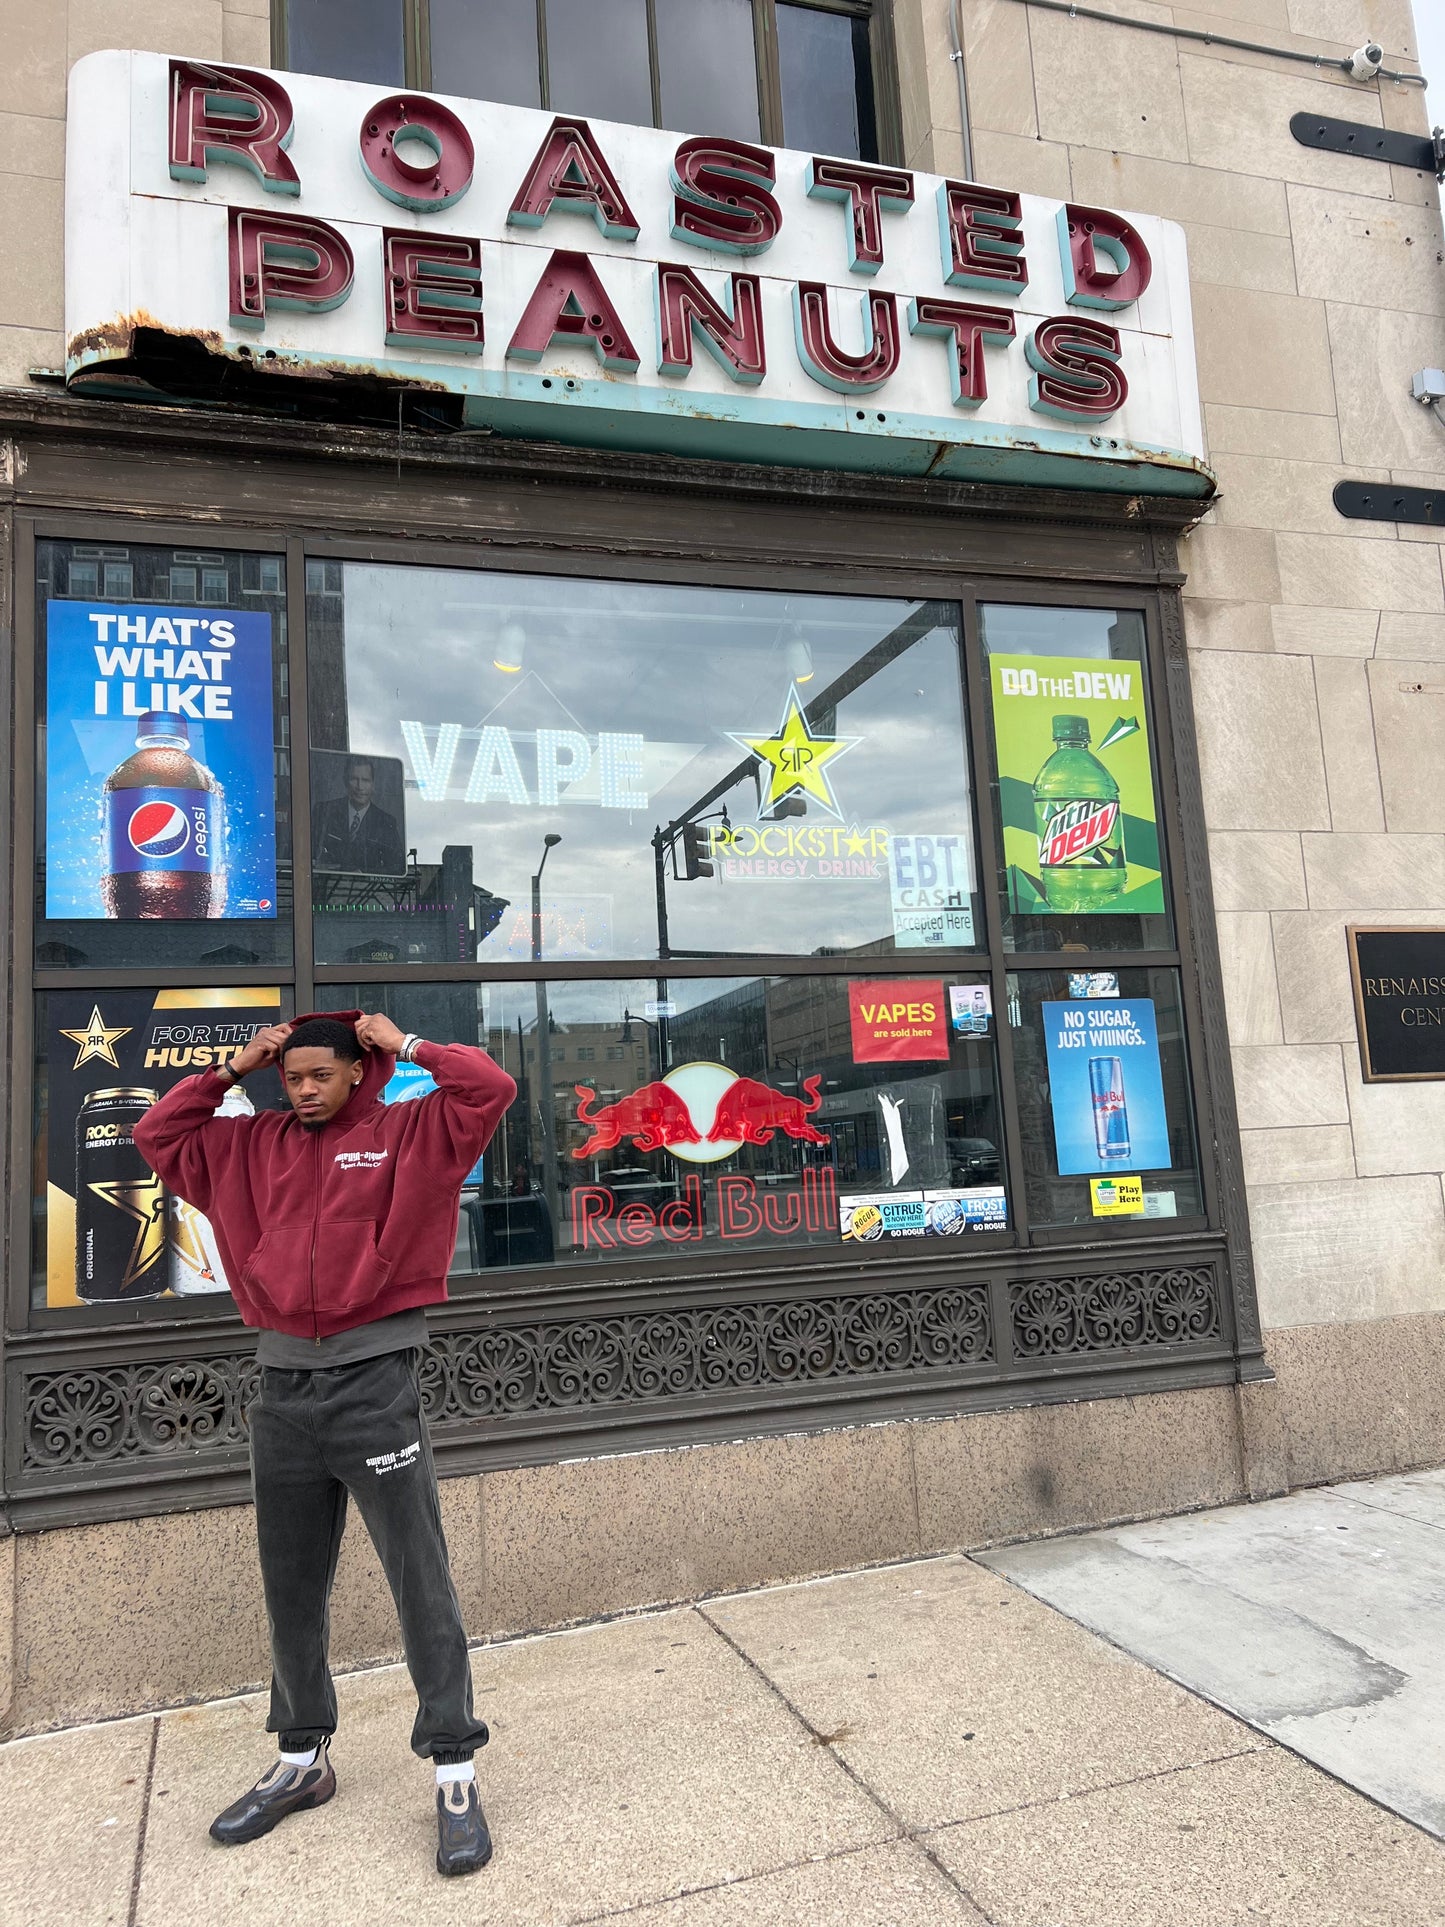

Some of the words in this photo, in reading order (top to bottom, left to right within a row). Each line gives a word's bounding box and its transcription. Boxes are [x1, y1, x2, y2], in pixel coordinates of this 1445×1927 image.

[168, 58, 1153, 311] ROASTED
[227, 206, 1129, 423] PEANUTS
[89, 612, 236, 649] THAT'S
[94, 646, 231, 682] WHAT
[1000, 667, 1039, 696] DO
[1038, 677, 1074, 698] THE
[94, 680, 108, 716] I
[122, 682, 233, 720] LIKE
[399, 719, 649, 810] VAPE
[191, 806, 209, 858] pepsi
[726, 857, 809, 877] ENERGY
[818, 858, 879, 877] DRINK
[892, 835, 959, 889] EBT
[900, 889, 962, 907] CASH
[507, 913, 586, 945] ATM
[896, 912, 945, 935] Accepted
[946, 912, 972, 930] Here
[860, 1002, 937, 1024] VAPES
[1063, 1010, 1085, 1028] NO
[1087, 1009, 1136, 1029] SUGAR,
[151, 1025, 211, 1045] FOR
[873, 1030, 889, 1038] are
[890, 1028, 910, 1037] sold
[912, 1028, 933, 1037] here
[1057, 1030, 1087, 1049] JUST
[85, 1138, 118, 1149] ENERGY
[340, 1161, 356, 1170] Sport
[1119, 1185, 1140, 1195] Play
[1119, 1195, 1141, 1204] Here
[571, 1173, 703, 1251] Red
[717, 1166, 838, 1240] Bull
[883, 1203, 923, 1217] CITRUS
[966, 1199, 1004, 1213] FROST
[854, 1208, 876, 1229] ROGUE
[973, 1223, 984, 1232] GO
[984, 1221, 1007, 1231] ROGUE
[890, 1228, 902, 1238] GO
[902, 1227, 926, 1237] ROGUE
[86, 1228, 95, 1280] ORIGINAL
[375, 1465, 393, 1476] Sport
